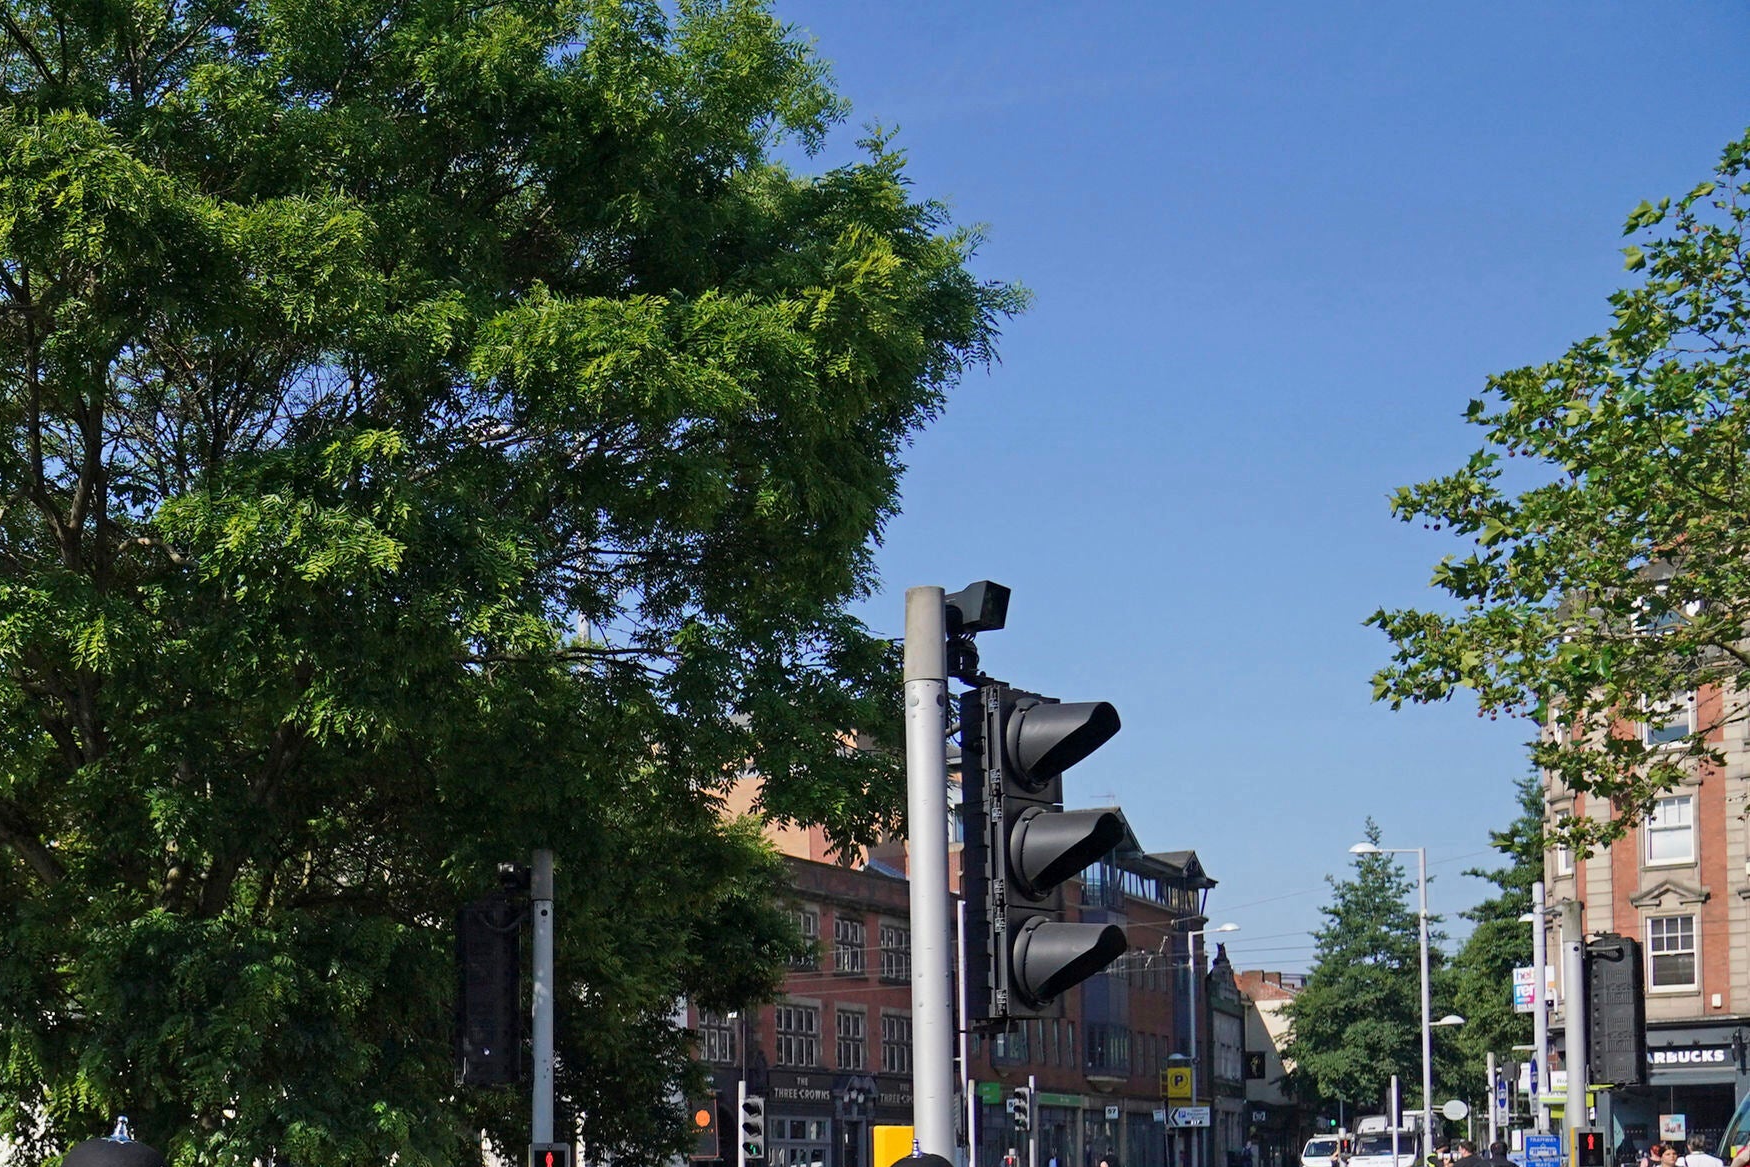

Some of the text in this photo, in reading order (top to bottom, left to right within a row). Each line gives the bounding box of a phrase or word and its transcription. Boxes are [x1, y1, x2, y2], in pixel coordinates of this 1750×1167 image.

[797, 1077, 809, 1086] THE
[774, 1088, 830, 1101] THREE CROWNS
[880, 1093, 900, 1104] THREE
